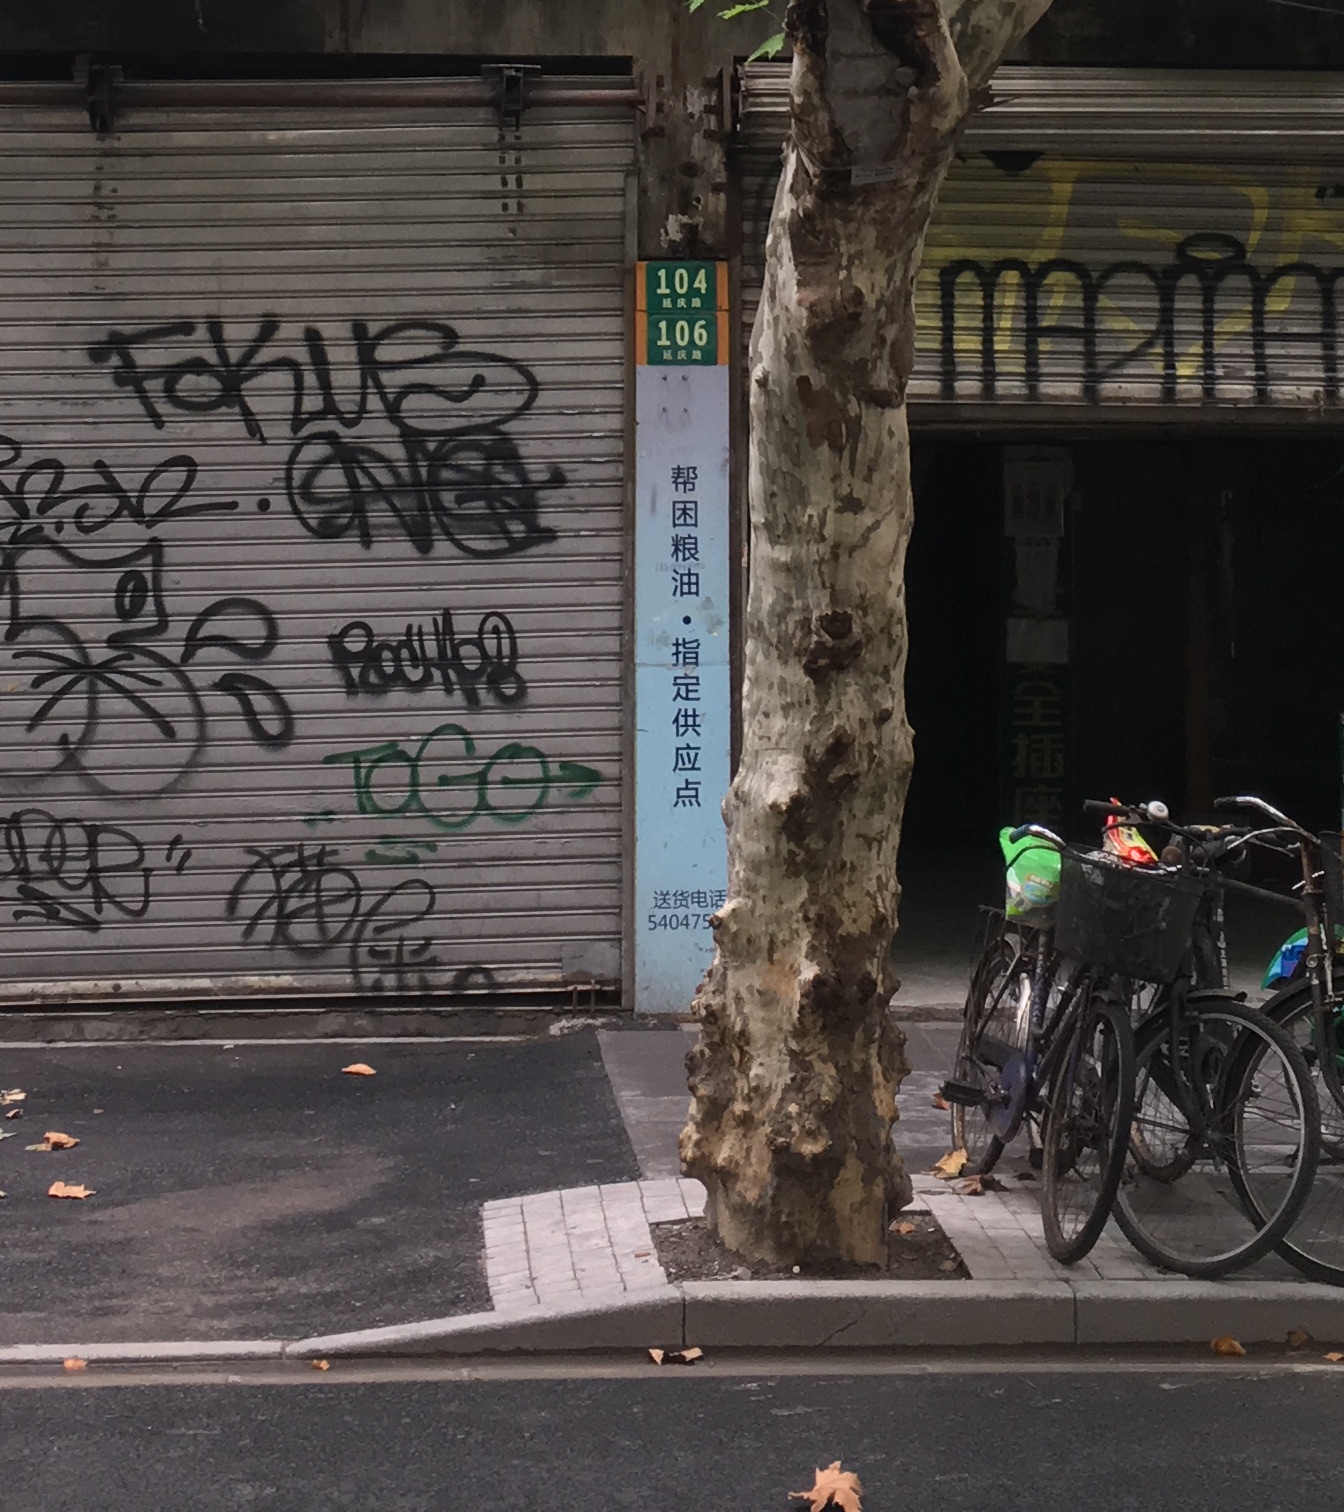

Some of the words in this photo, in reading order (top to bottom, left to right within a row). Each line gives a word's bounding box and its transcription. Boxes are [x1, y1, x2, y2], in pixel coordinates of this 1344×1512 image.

[656, 268, 708, 295] 104
[656, 319, 708, 346] 106
[653, 889, 728, 909] 送货电话
